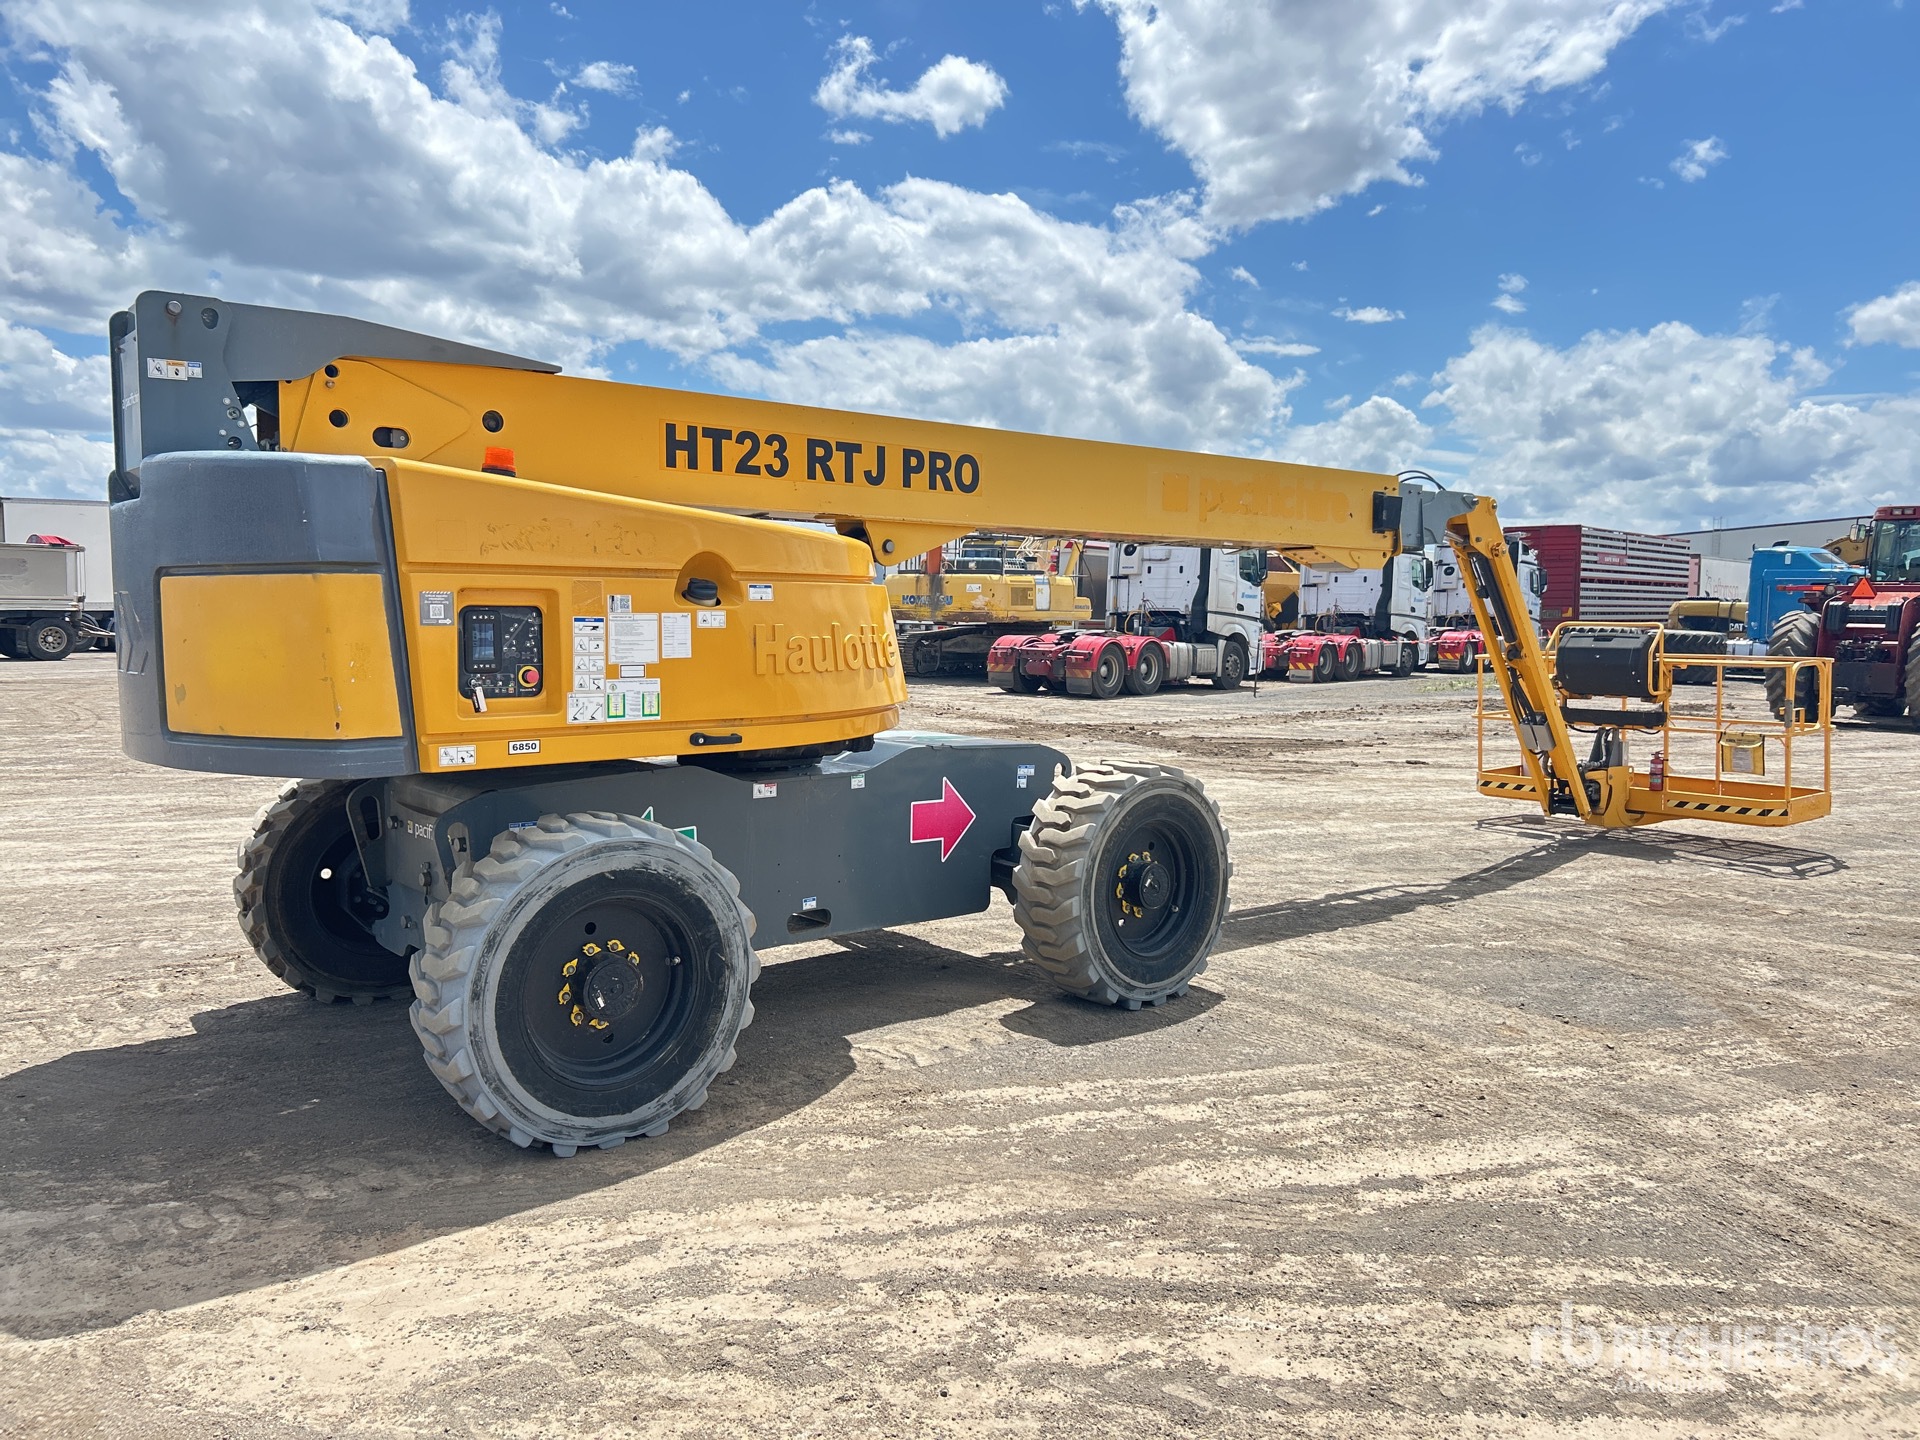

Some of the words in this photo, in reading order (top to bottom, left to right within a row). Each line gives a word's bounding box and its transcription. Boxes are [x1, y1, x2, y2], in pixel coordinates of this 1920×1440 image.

[665, 422, 789, 478] HT23
[806, 438, 886, 486] RTJ
[902, 448, 980, 494] PRO
[1729, 622, 1744, 632] CAT
[754, 622, 897, 675] Haulotte
[512, 742, 537, 752] 6850
[414, 823, 434, 840] pacif
